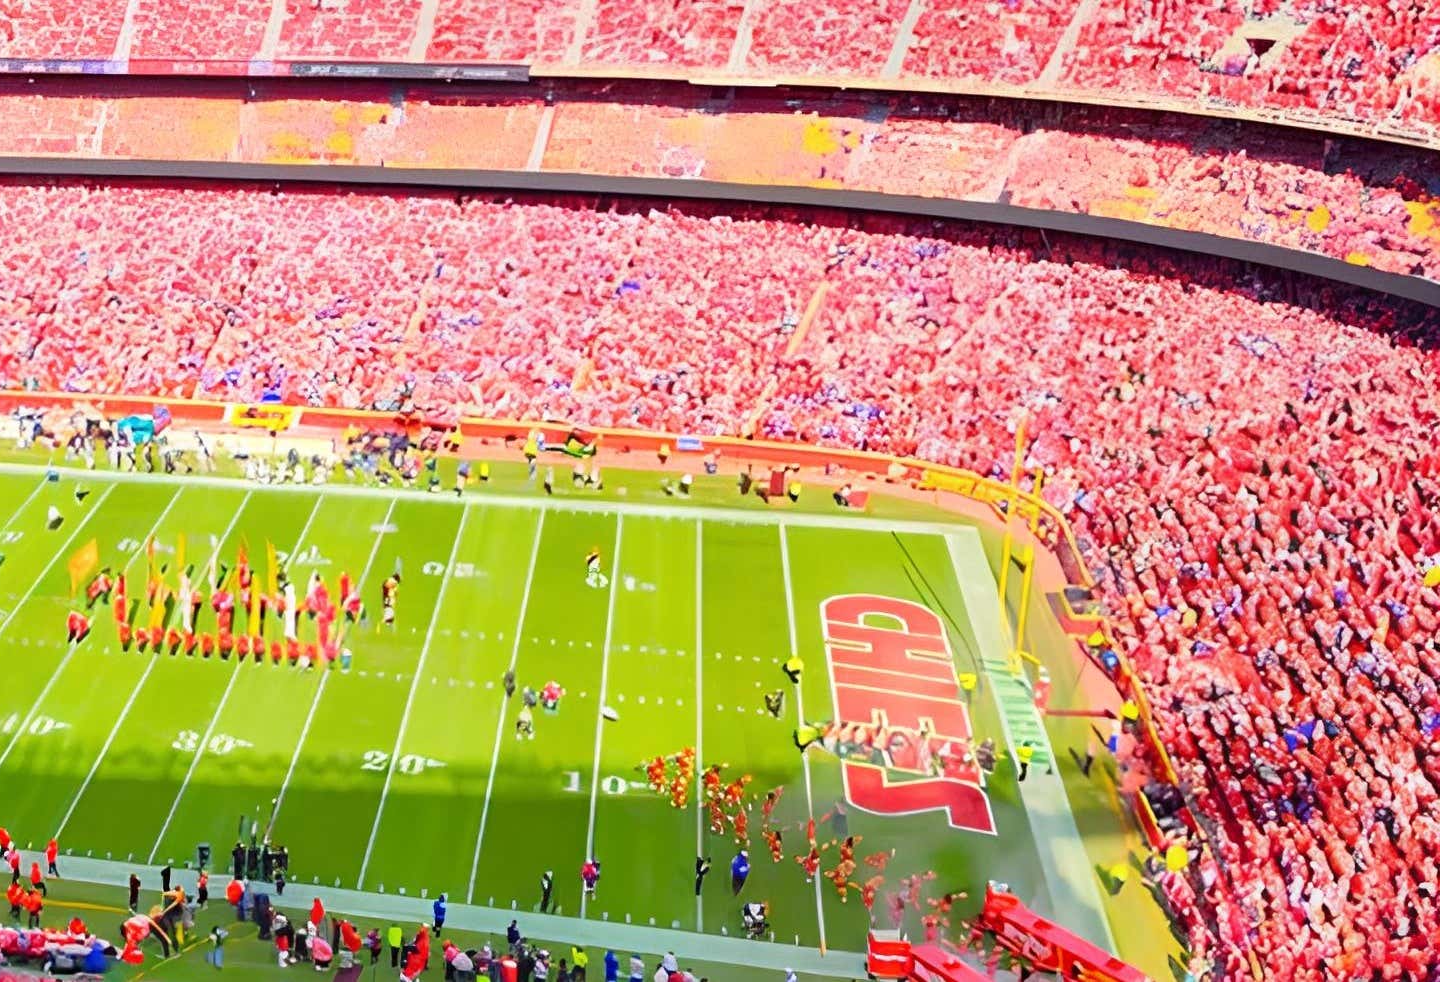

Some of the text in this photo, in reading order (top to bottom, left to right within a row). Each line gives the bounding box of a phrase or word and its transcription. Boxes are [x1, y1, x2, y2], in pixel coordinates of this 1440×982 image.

[171, 730, 235, 756] 30
[360, 750, 425, 775] 20
[562, 771, 628, 795] 10
